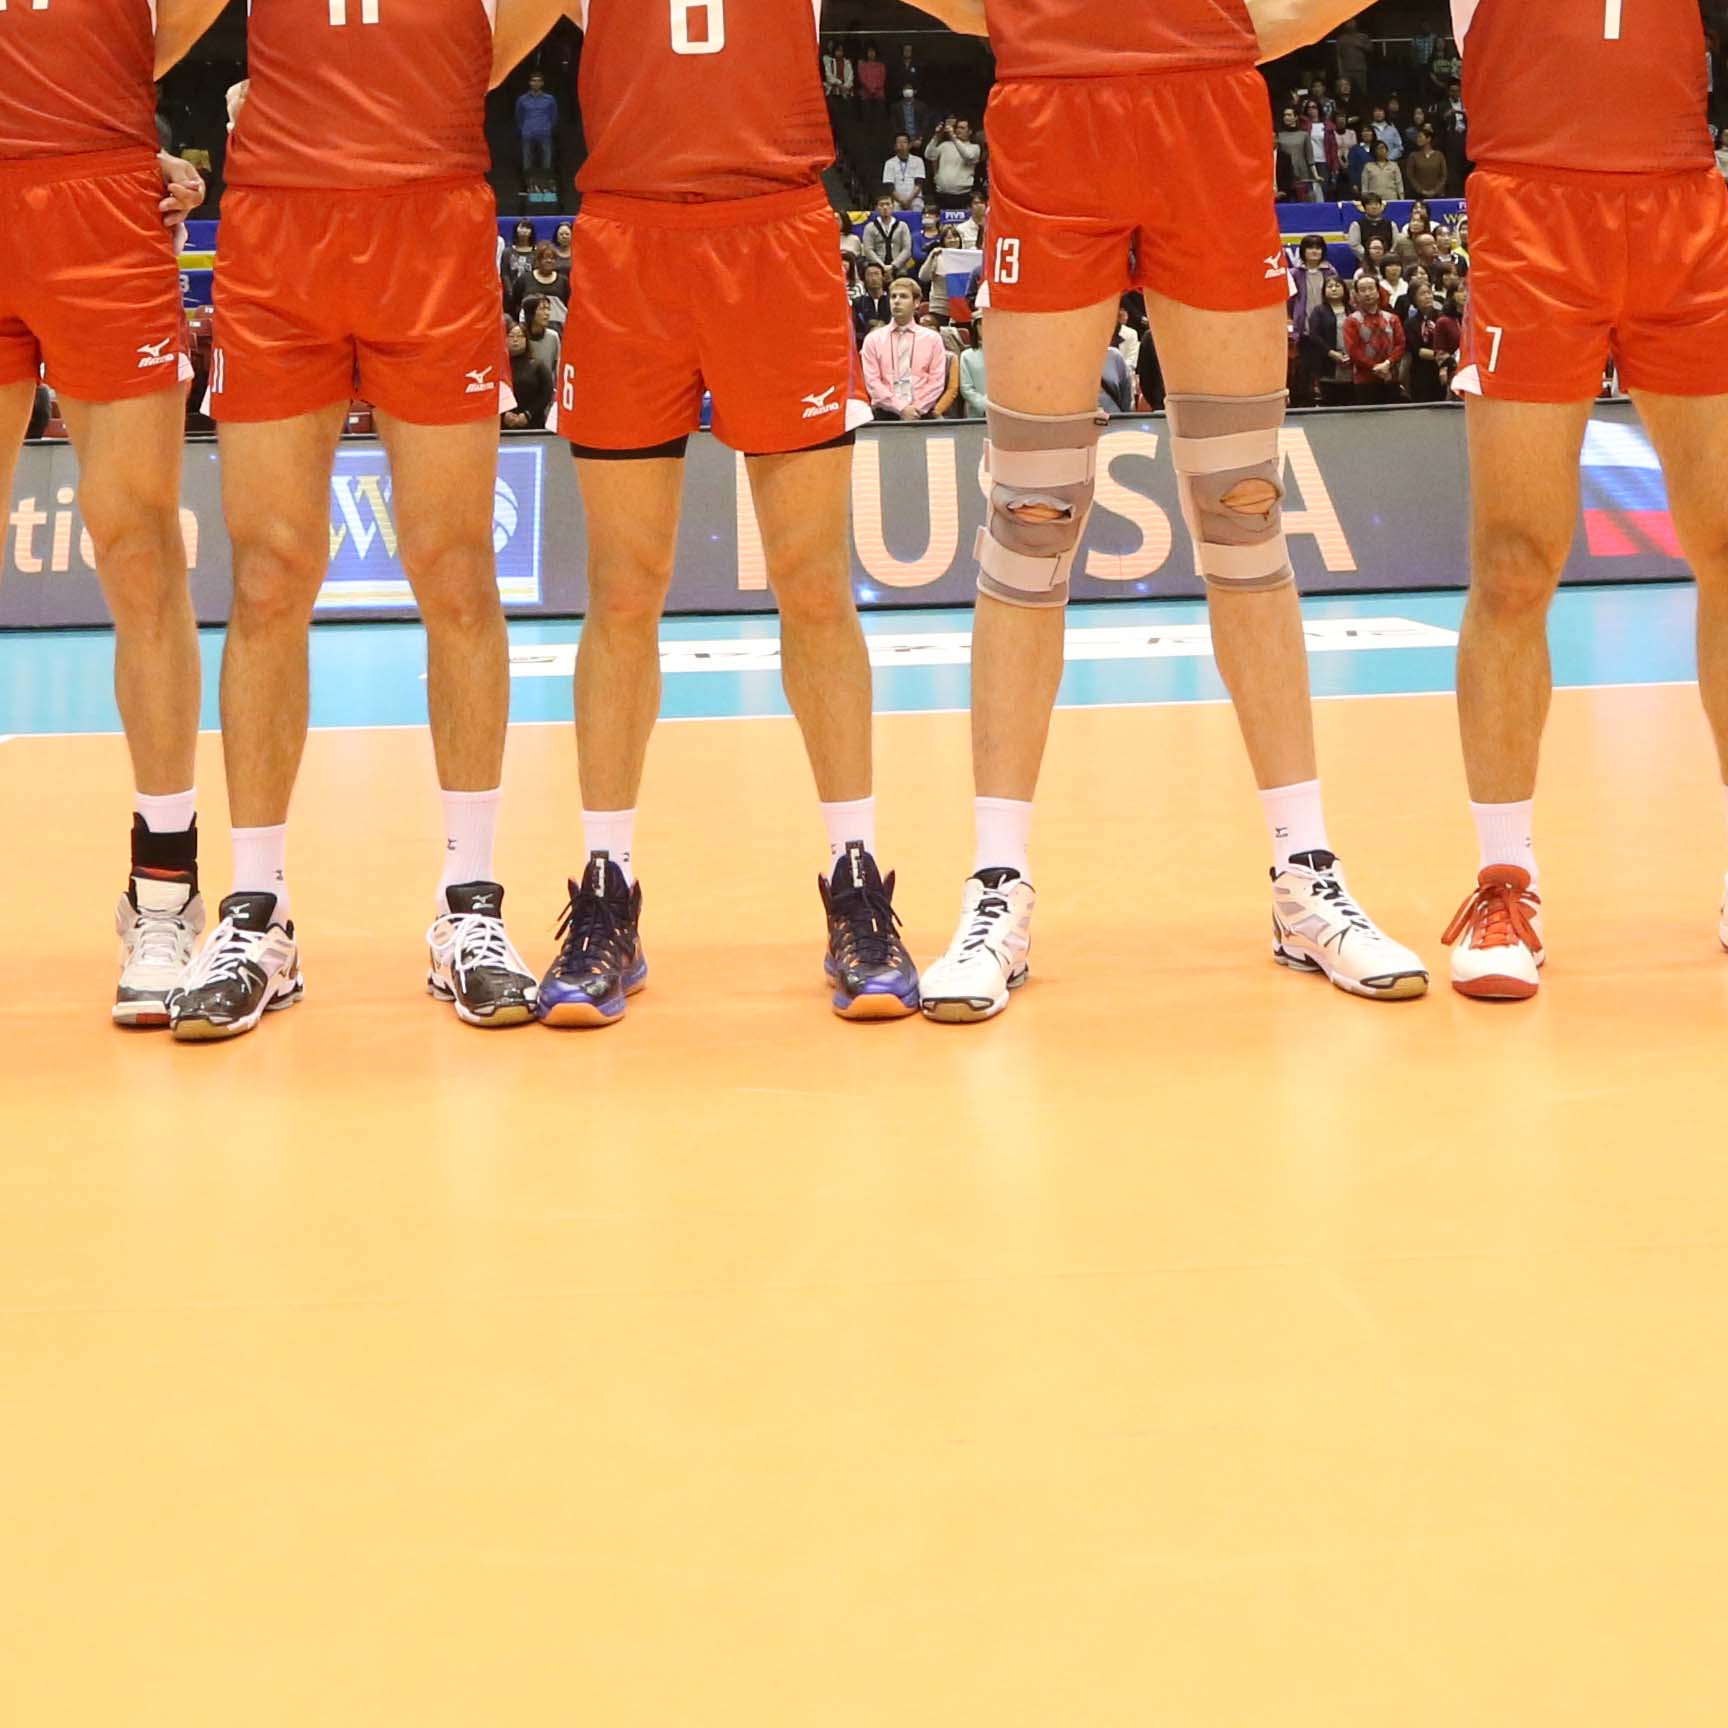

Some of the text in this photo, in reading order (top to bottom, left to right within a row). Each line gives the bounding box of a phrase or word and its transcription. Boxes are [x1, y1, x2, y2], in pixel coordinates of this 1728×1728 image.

[994, 237, 1020, 284] 13
[1486, 325, 1503, 373] 7
[563, 364, 575, 411] 6
